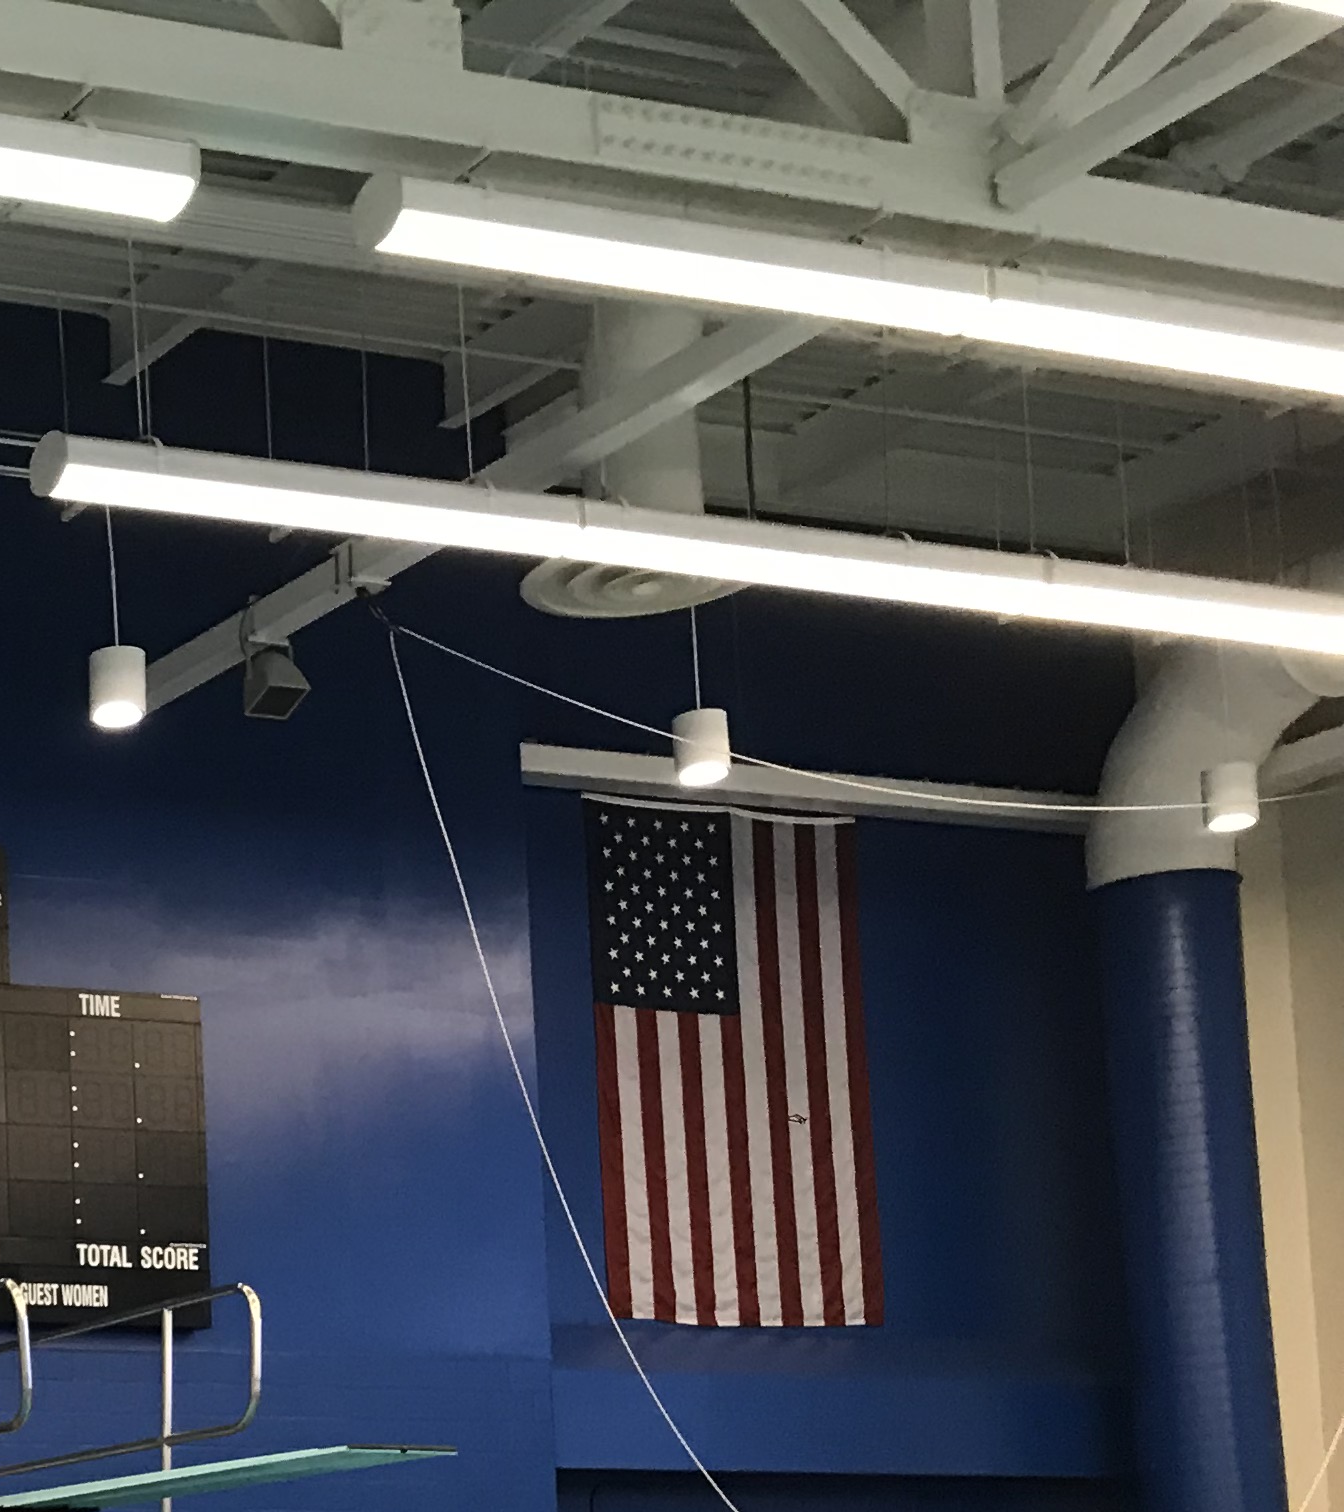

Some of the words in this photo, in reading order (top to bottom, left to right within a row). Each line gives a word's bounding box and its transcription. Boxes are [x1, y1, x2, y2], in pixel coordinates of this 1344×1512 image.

[79, 994, 120, 1019] TIME
[77, 1244, 132, 1268] TOTAL
[141, 1246, 199, 1270] SCORE
[21, 1282, 59, 1305] GUEST
[63, 1284, 108, 1307] WOMEN
